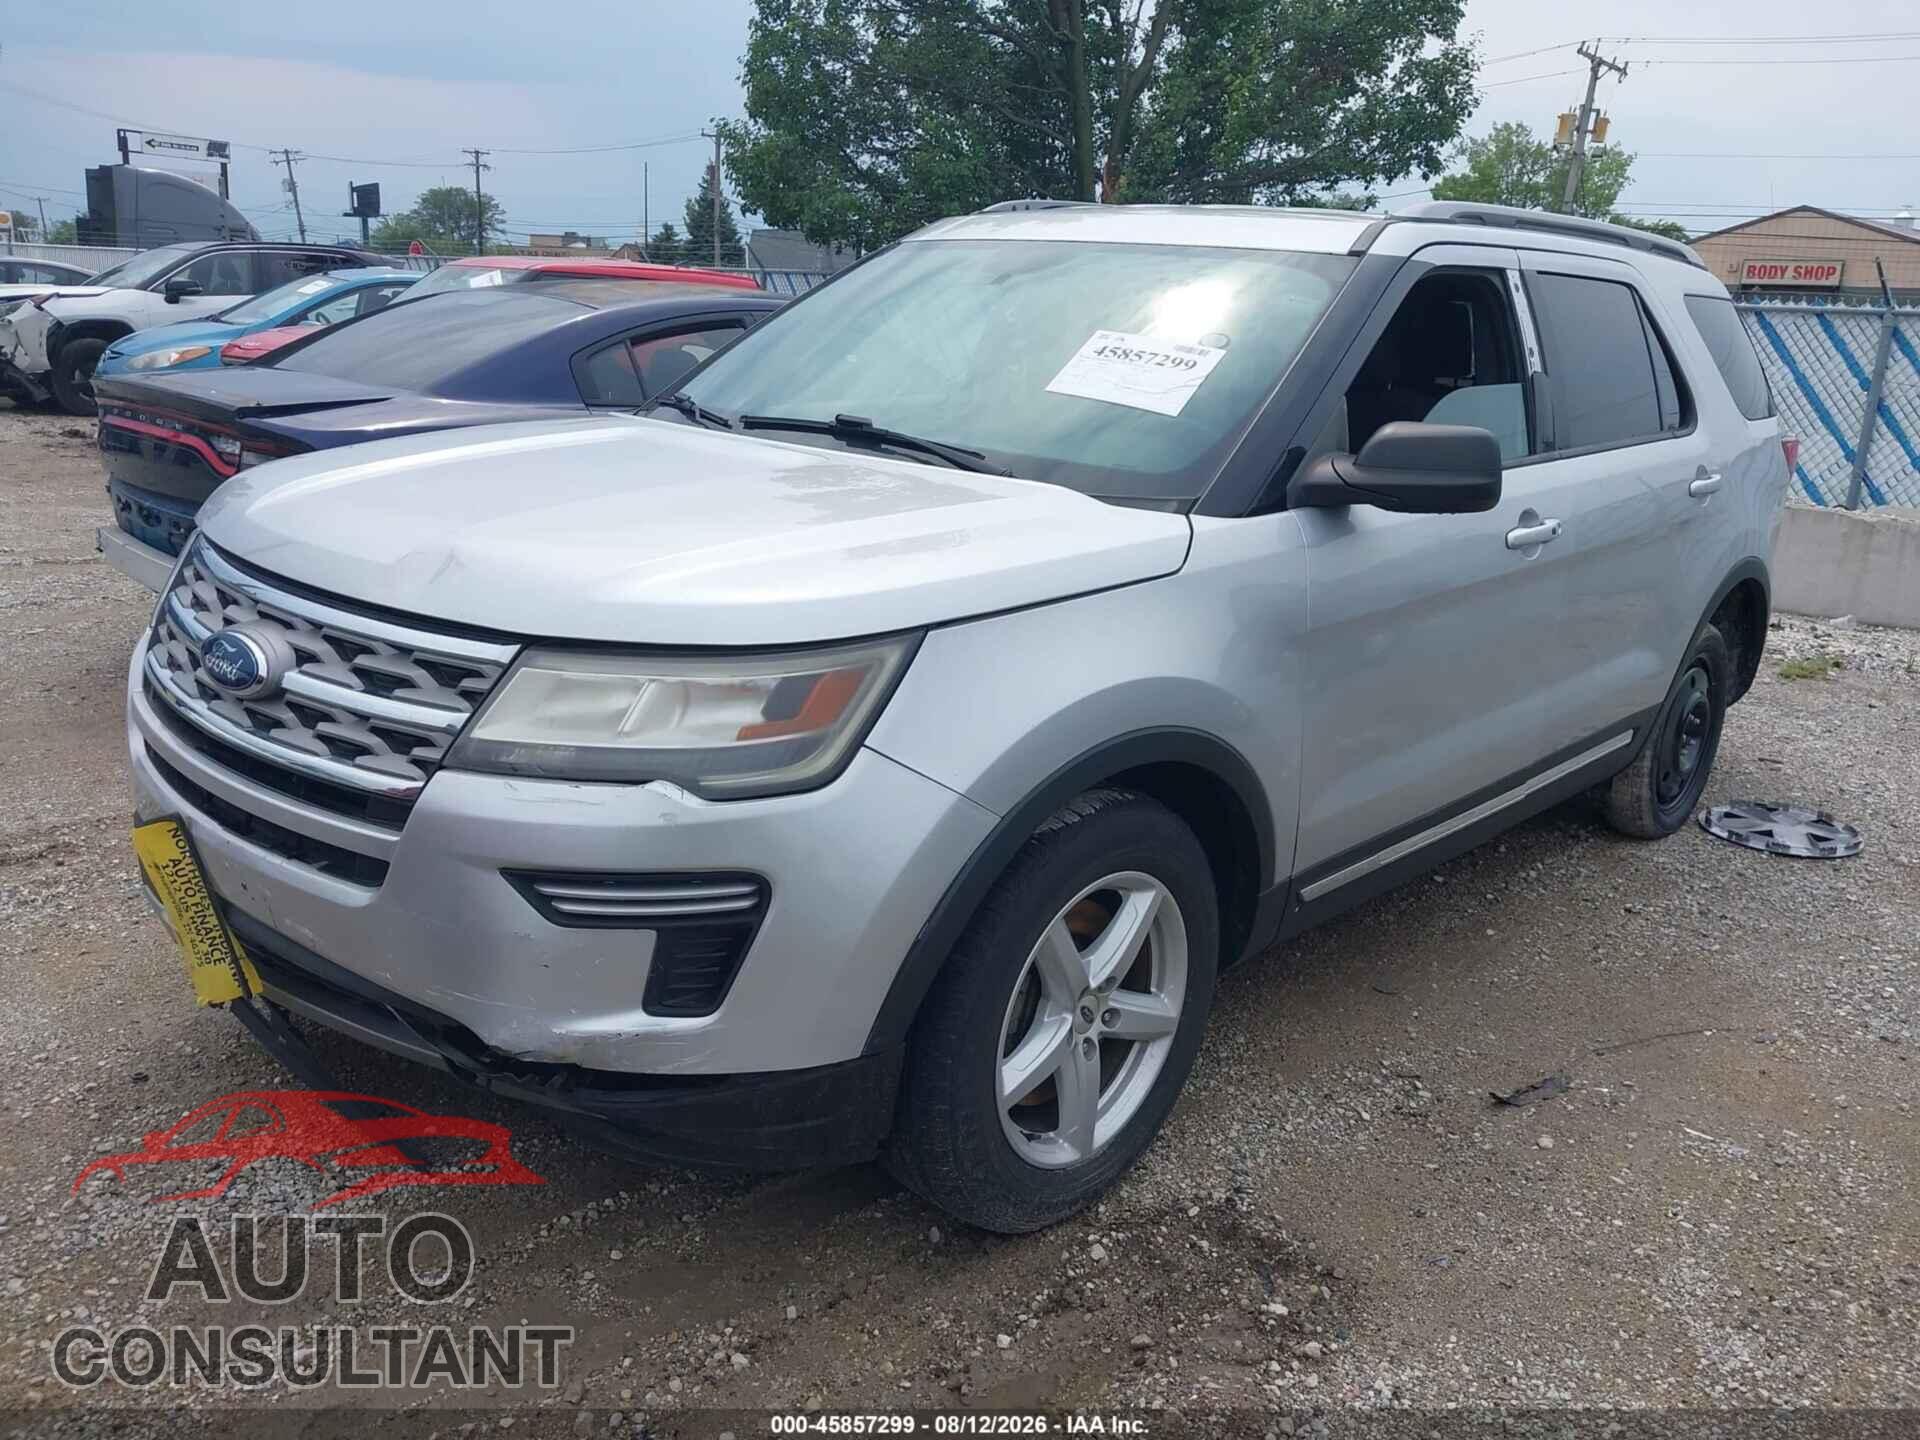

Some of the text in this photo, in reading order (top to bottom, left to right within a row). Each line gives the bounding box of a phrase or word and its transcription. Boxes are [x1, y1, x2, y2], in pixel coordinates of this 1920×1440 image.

[1746, 264, 1837, 281] BODY SHOP
[1093, 345, 1198, 371] 45857299
[206, 639, 243, 681] Ford
[167, 827, 214, 919] NORTHWEST
[161, 864, 182, 892] 1212
[179, 896, 190, 913] US
[189, 916, 207, 944] HWY
[168, 858, 226, 967] AUTO FINANCE
